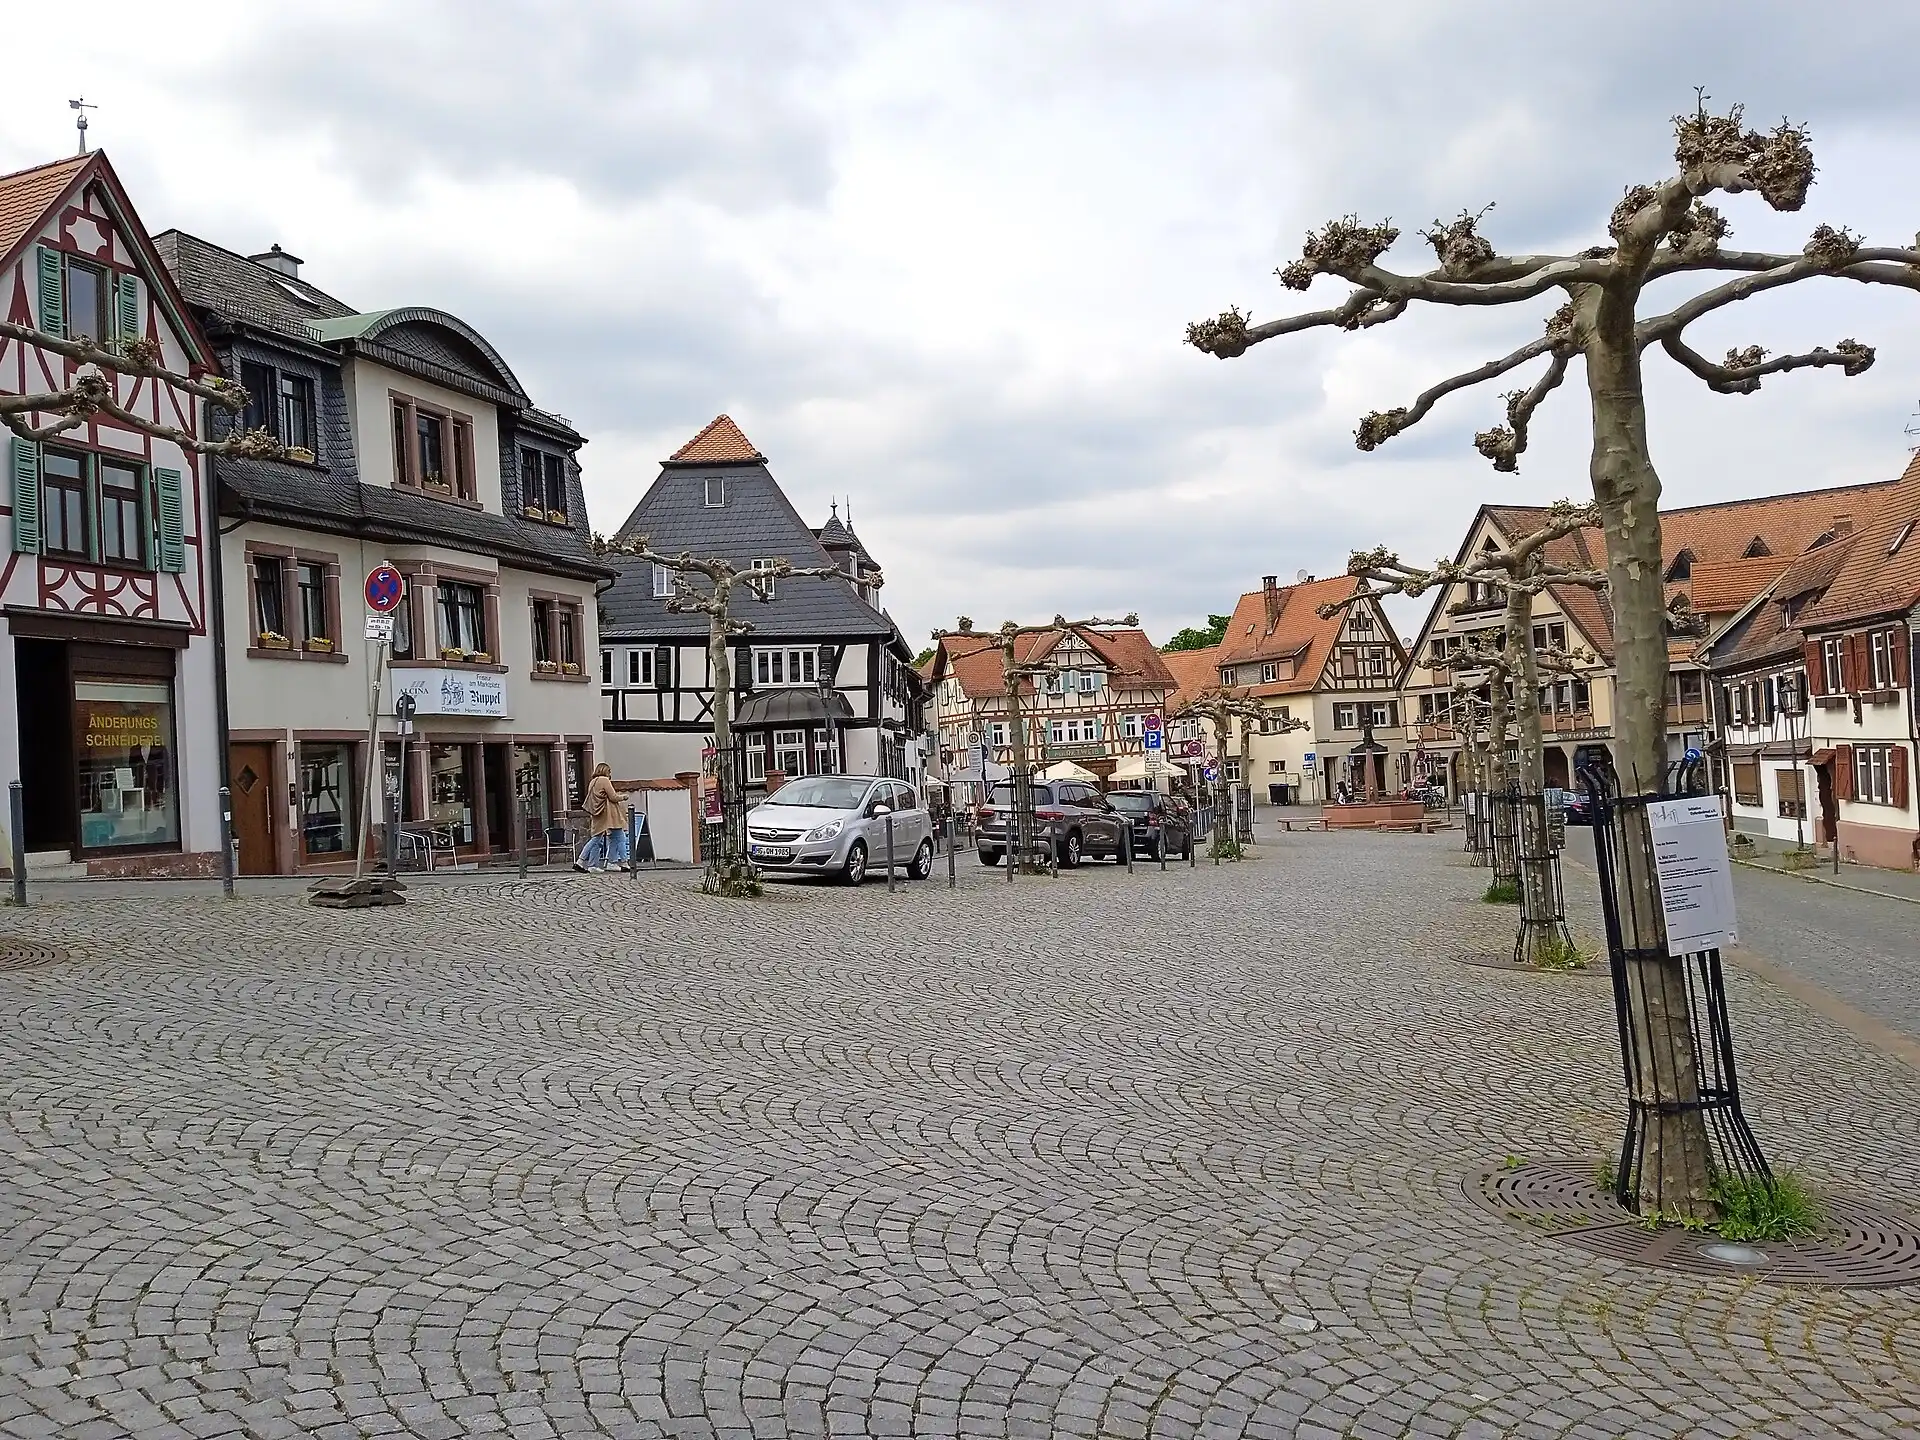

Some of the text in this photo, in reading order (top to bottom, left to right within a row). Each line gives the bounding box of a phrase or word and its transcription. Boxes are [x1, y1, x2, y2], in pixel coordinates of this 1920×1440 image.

[88, 713, 158, 728] ÄNDERUNGS
[86, 734, 165, 747] SCHNEIDEREI
[1148, 732, 1158, 747] P
